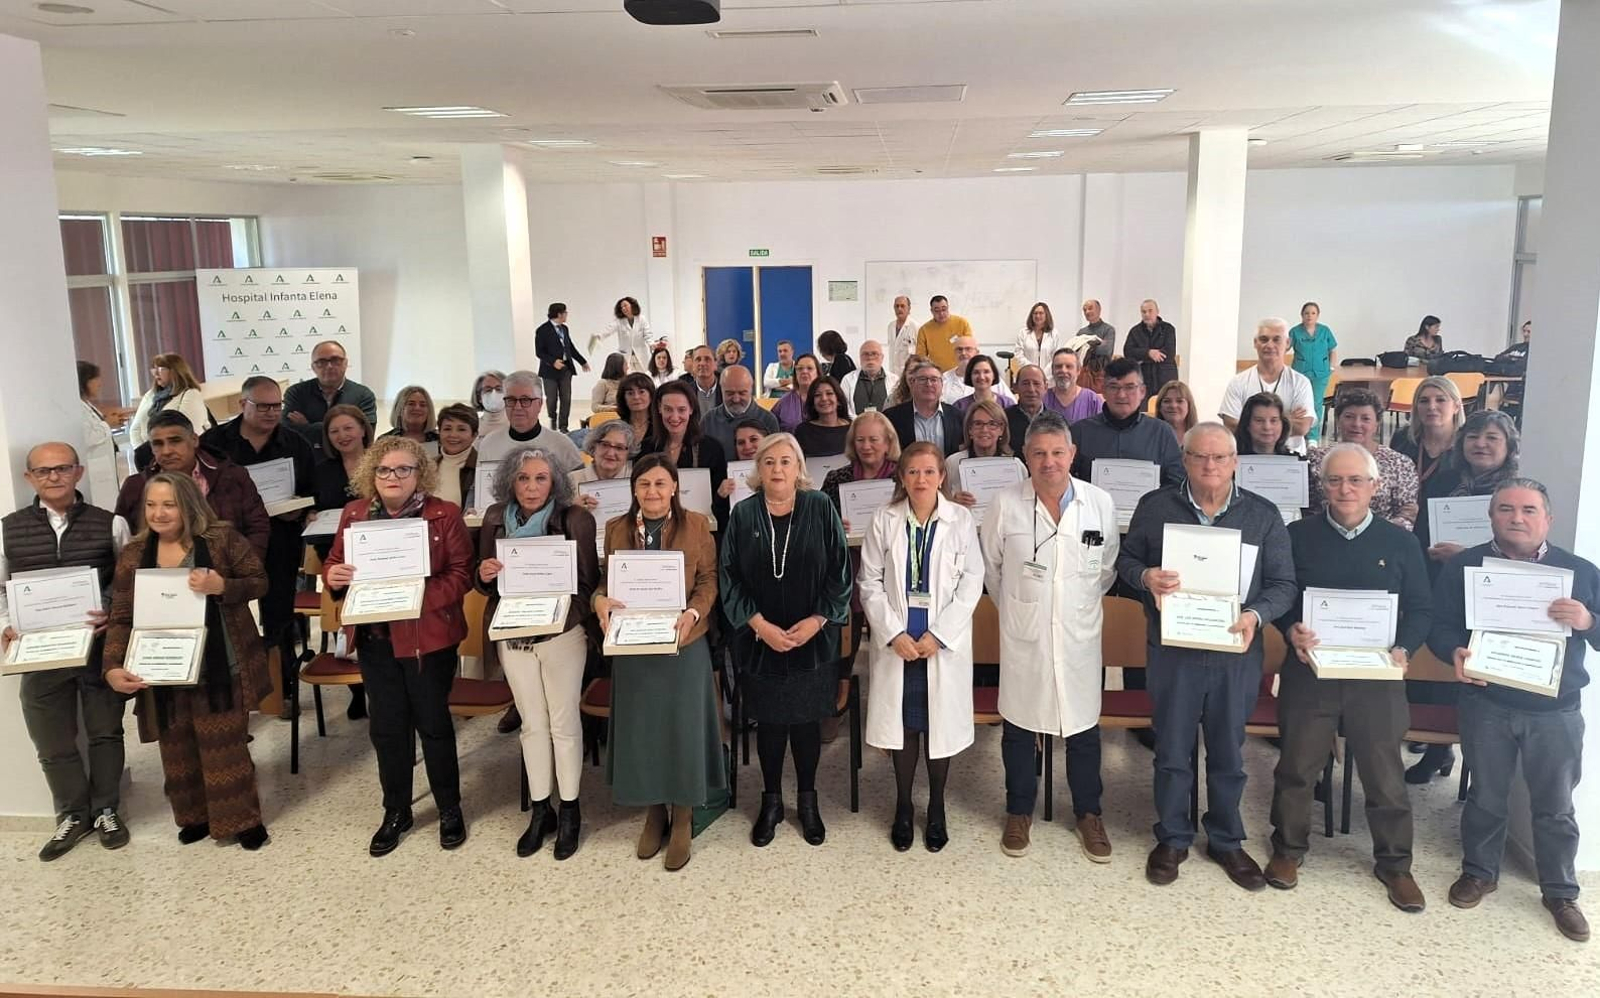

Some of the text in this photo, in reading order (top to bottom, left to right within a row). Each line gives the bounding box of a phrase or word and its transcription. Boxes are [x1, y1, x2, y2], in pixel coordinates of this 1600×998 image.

[222, 291, 338, 304] Hospital Infanta Elena
